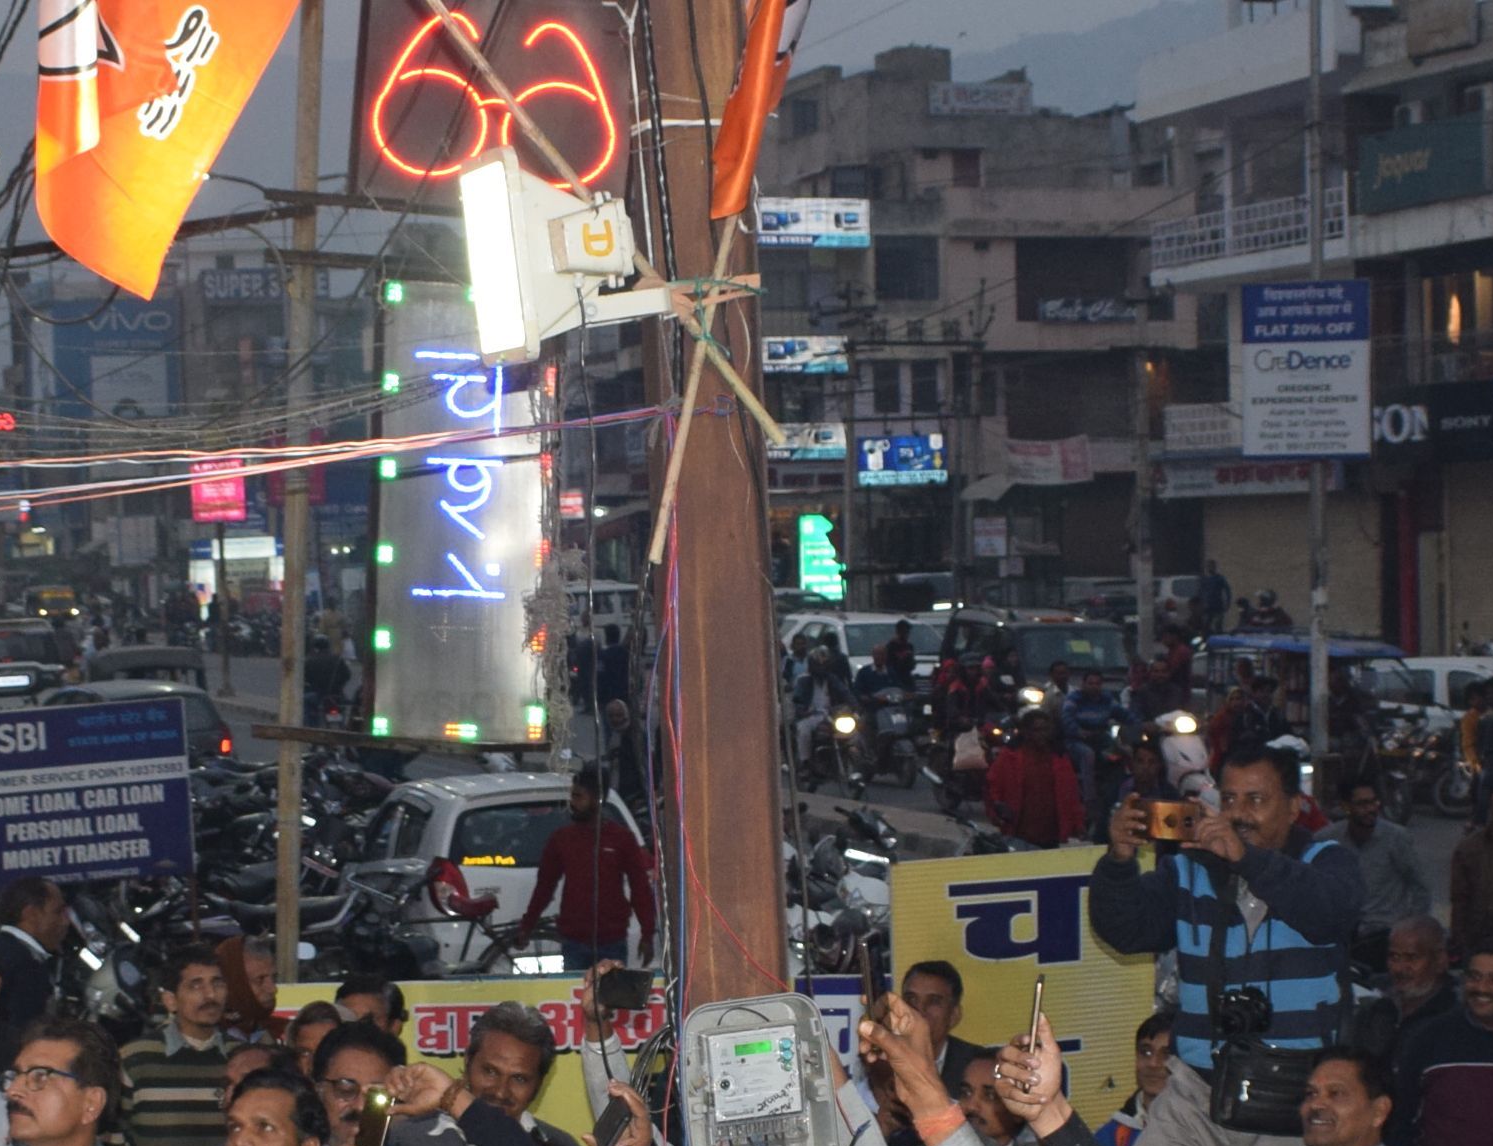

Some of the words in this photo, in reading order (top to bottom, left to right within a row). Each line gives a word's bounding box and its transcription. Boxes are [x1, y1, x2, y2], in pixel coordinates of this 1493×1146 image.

[204, 273, 263, 299] SUPER
[88, 307, 172, 333] vivo
[1255, 324, 1289, 338] FLAT
[1292, 322, 1323, 336] 20%
[1326, 321, 1355, 335] OFF
[32, 767, 86, 785] SERVICE
[83, 787, 119, 809] CAR
[121, 783, 165, 806] LOAN
[6, 817, 93, 844] PERSONAL
[2, 846, 63, 871] MONEY
[64, 837, 151, 864] TRANSFER
